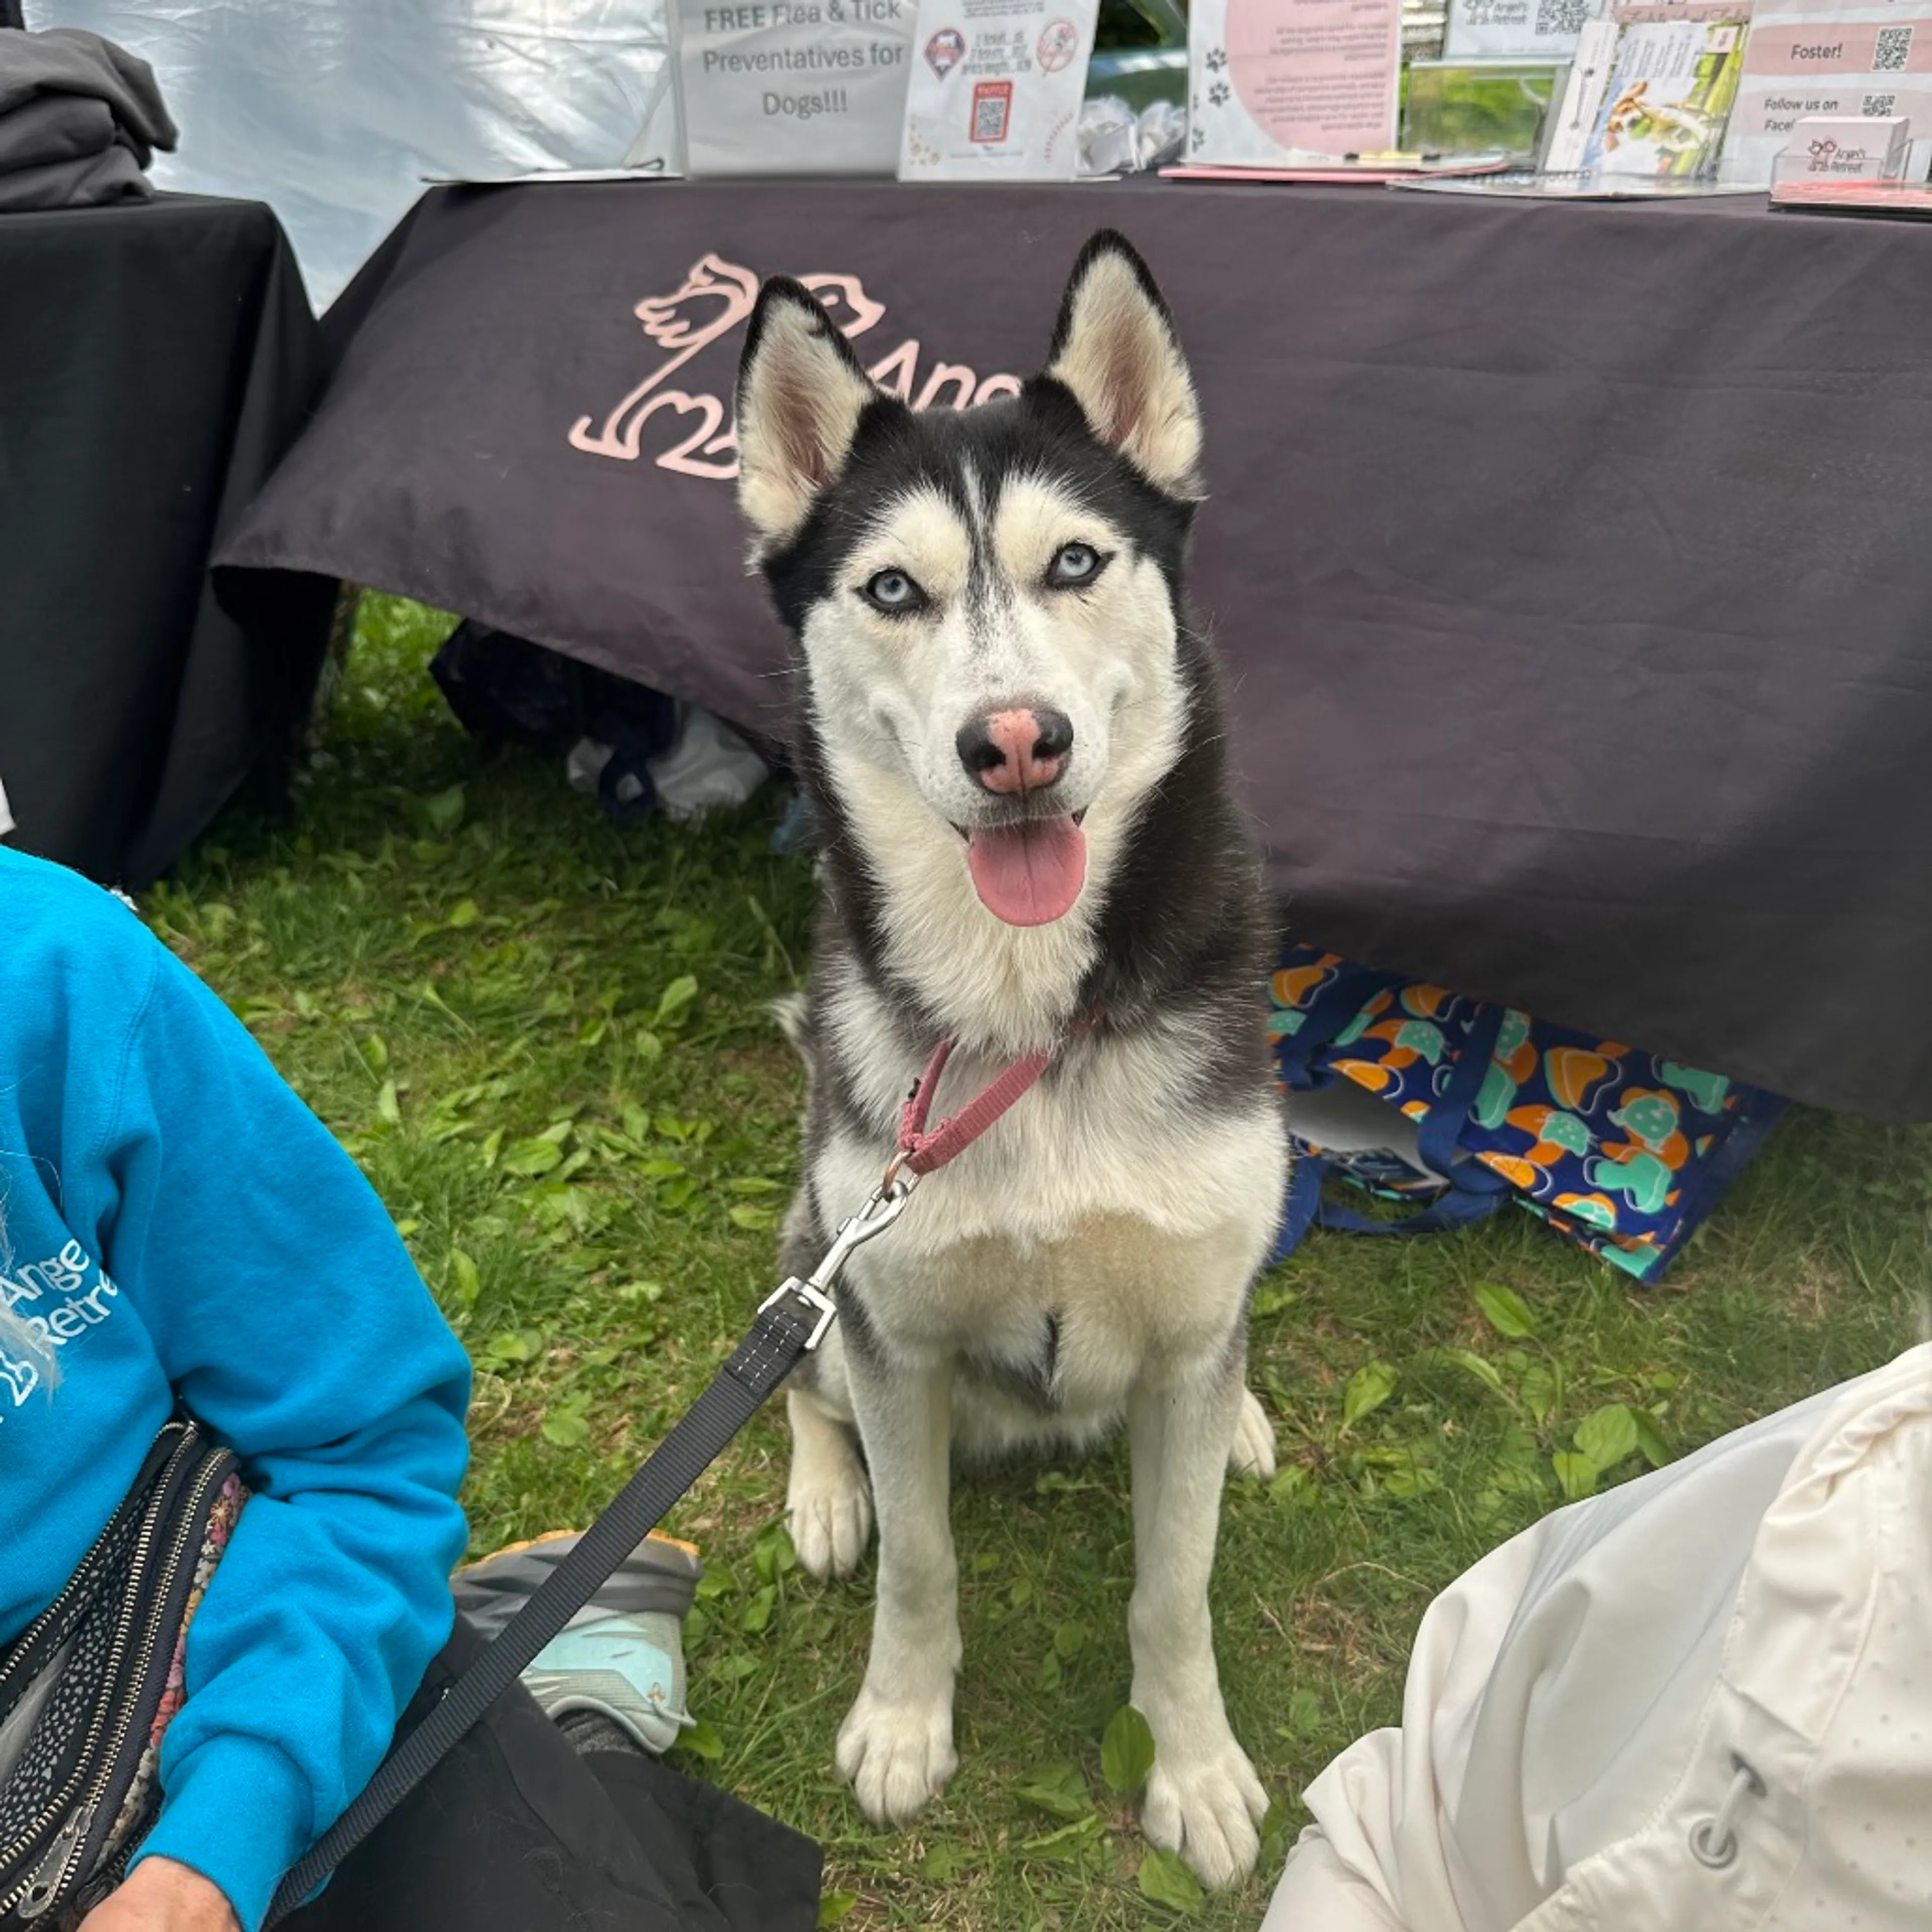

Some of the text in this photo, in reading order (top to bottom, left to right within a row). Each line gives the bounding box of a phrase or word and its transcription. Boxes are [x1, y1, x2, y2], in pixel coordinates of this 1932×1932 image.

[705, 0, 902, 30] FREE Flea & Tick
[704, 43, 904, 72] Preventatives for
[1791, 43, 1842, 59] Foster!
[763, 91, 848, 120] Dogs!!!
[1764, 98, 1802, 111] Follow
[1806, 100, 1820, 110] us
